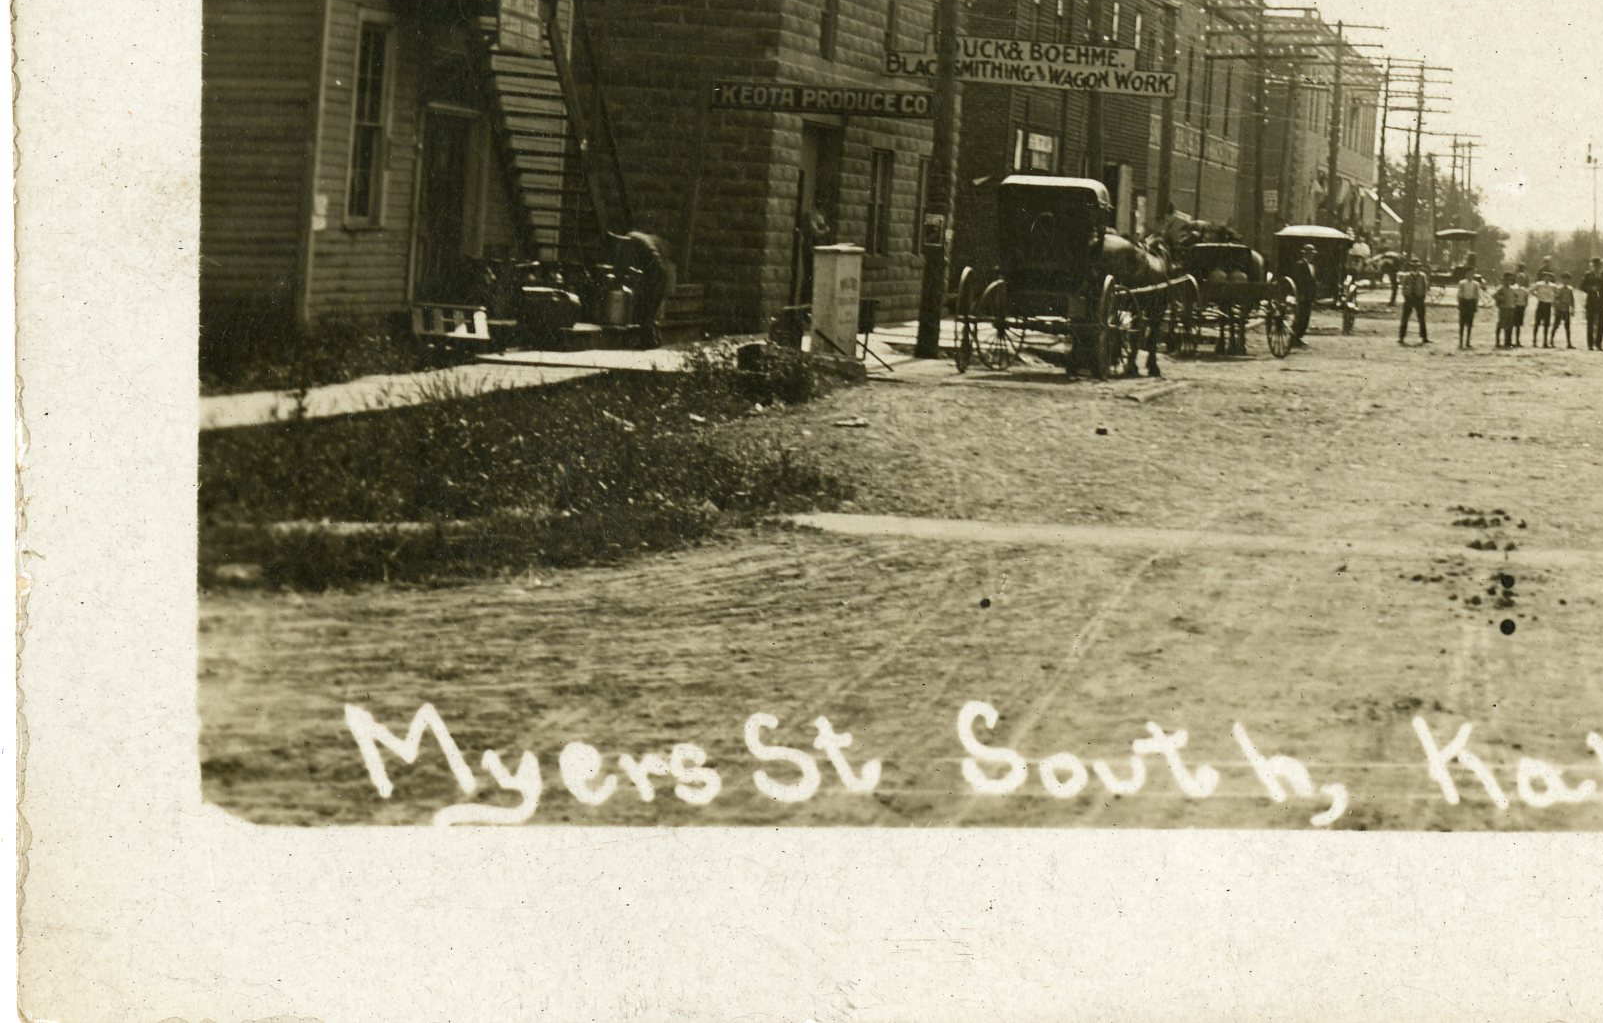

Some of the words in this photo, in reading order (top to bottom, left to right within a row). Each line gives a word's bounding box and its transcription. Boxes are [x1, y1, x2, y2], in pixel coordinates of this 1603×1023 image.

[1030, 42, 1126, 68] BOEHME.
[886, 53, 1035, 82] BLACSMITHING
[1048, 64, 1109, 89] WAGON
[1114, 70, 1174, 94] WORK.
[721, 84, 795, 107] KEOTA
[800, 88, 896, 112] PRODUCE
[899, 94, 928, 114] CO
